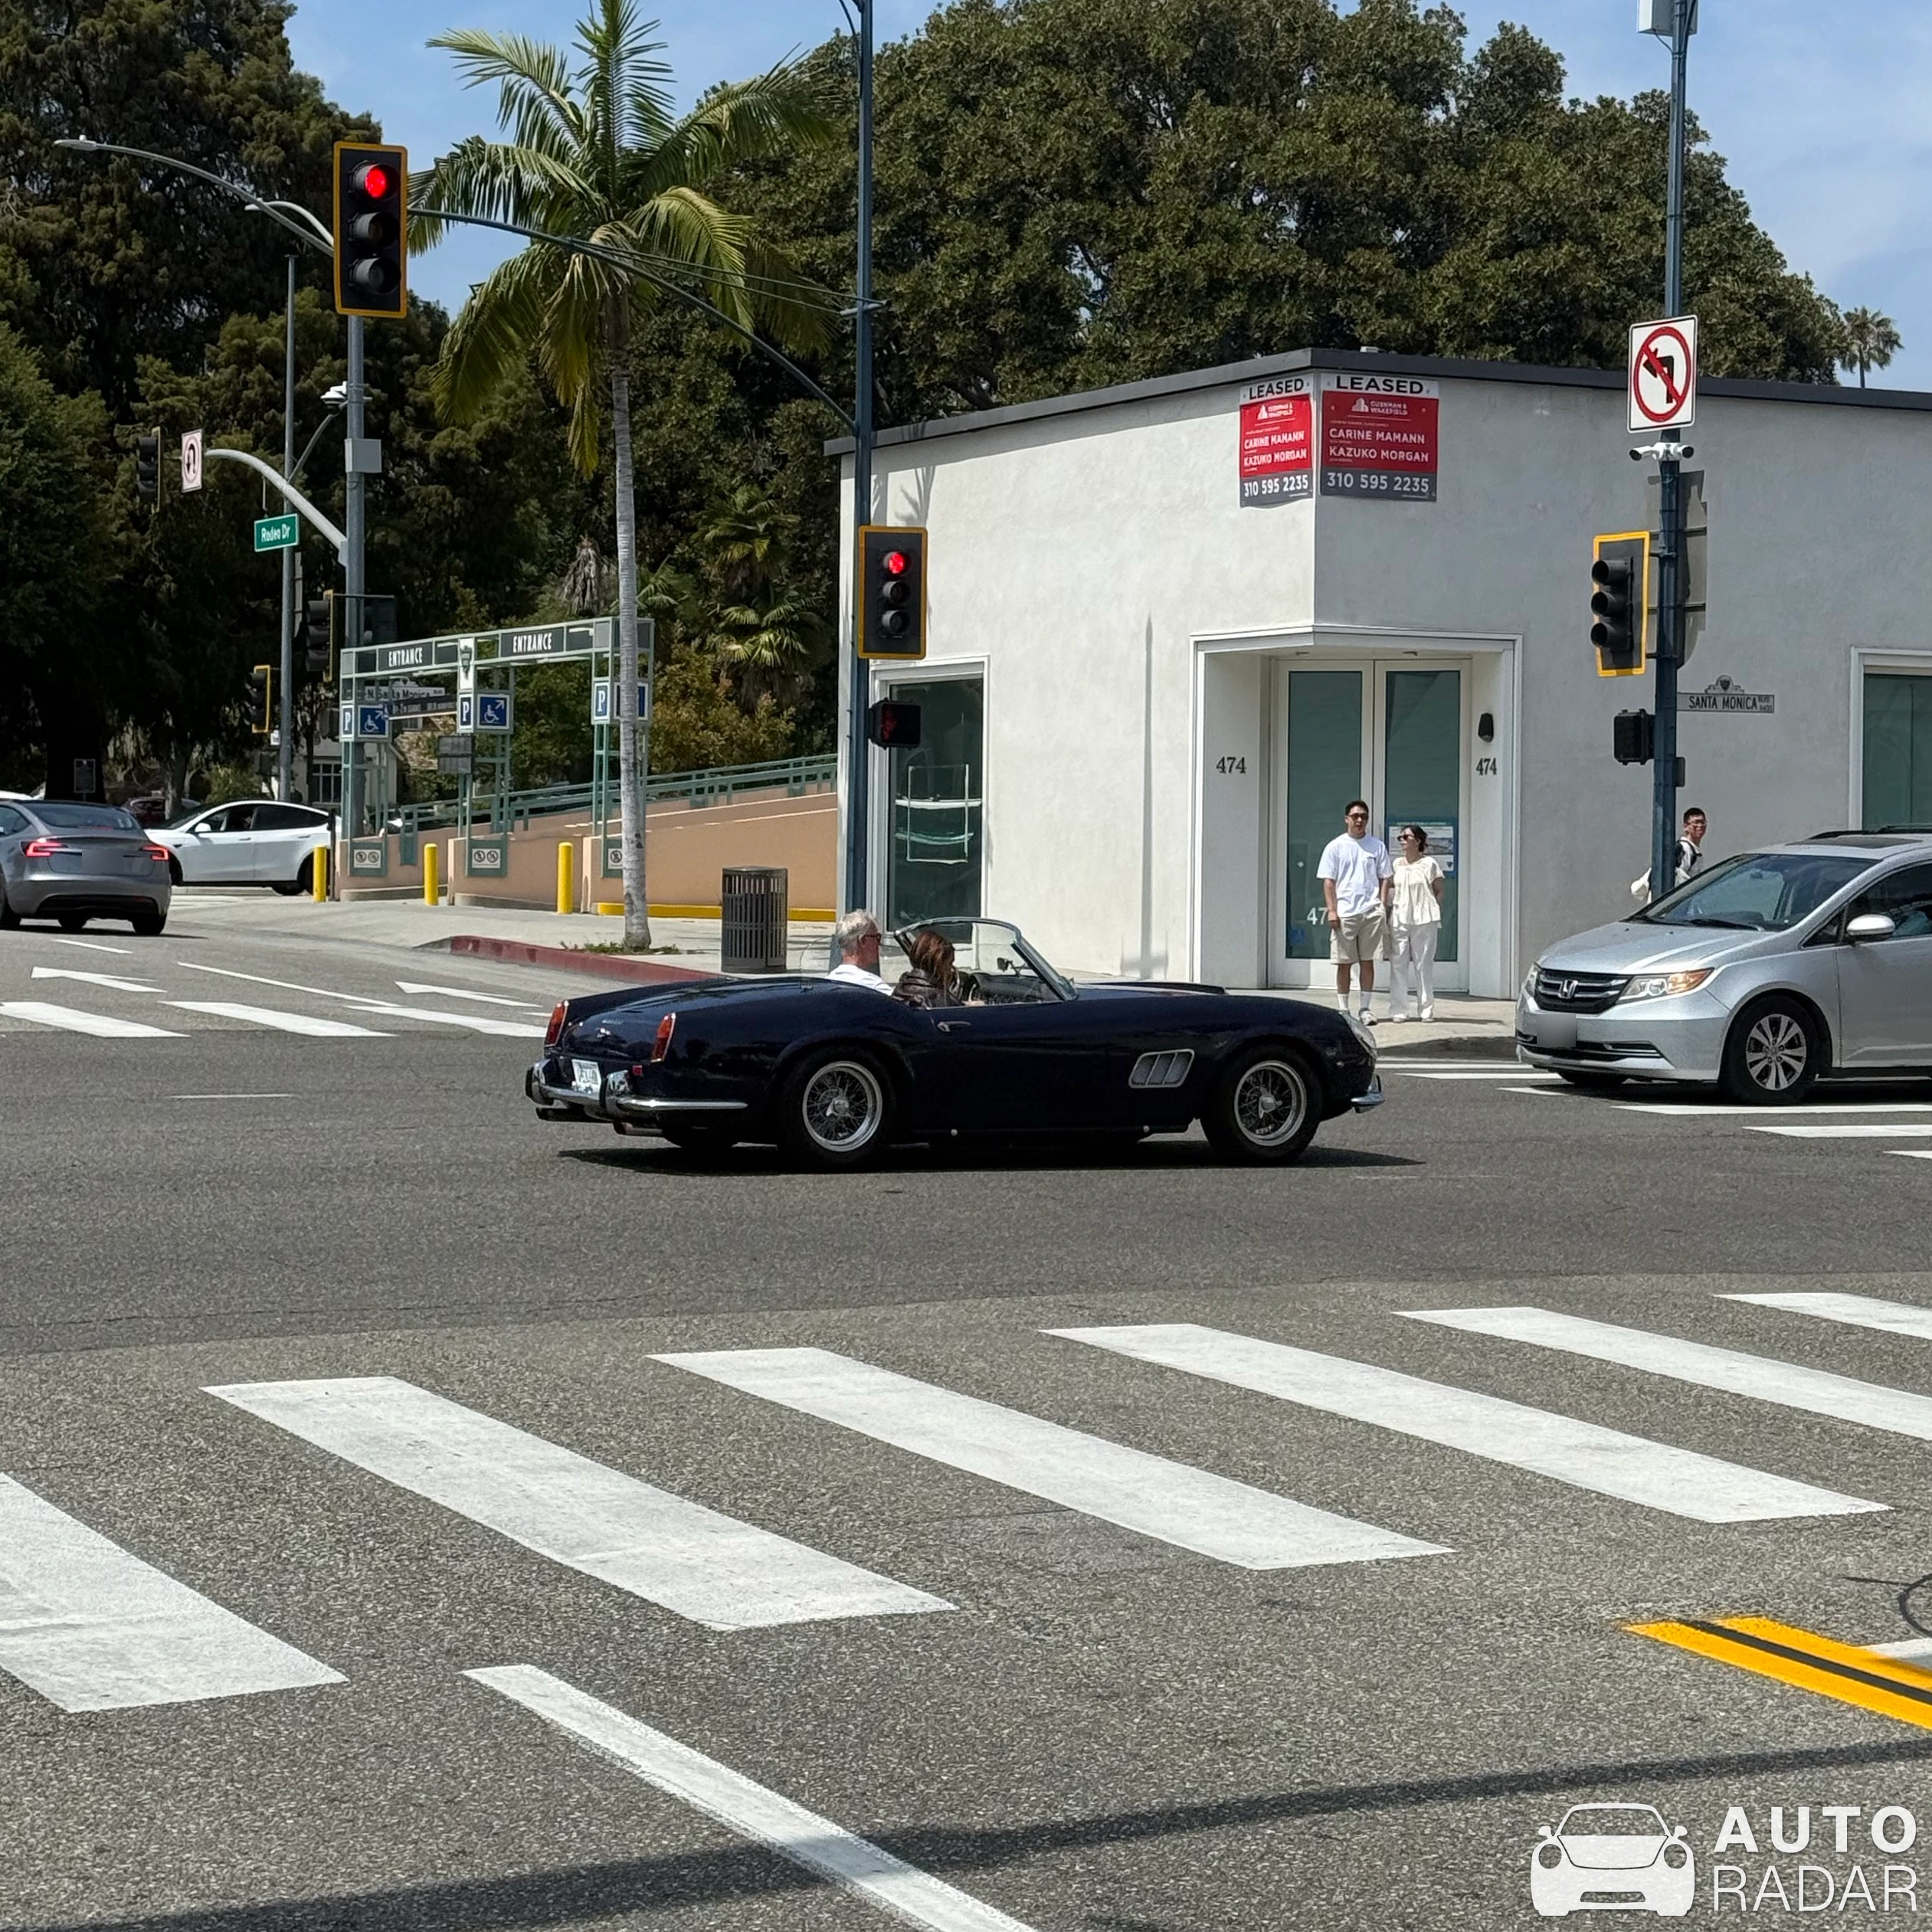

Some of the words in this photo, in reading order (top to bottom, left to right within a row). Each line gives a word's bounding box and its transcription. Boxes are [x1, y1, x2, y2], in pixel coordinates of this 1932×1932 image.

[1249, 378, 1304, 400] LEASED
[1336, 375, 1423, 395] LEASED
[1271, 431, 1305, 445] MAMANN
[1329, 428, 1373, 440] CARINE
[1376, 431, 1426, 444] MAMANN
[1244, 454, 1272, 467] KAZUKO
[1273, 448, 1307, 463] MORGAN
[1329, 446, 1377, 459] KAZUKO
[1380, 450, 1429, 463] MORGAN
[1244, 481, 1259, 497] 310
[1262, 478, 1280, 495] 595
[1283, 475, 1308, 492] 2235
[1327, 472, 1354, 488] 310
[1360, 474, 1388, 490] 595
[1393, 476, 1429, 493] 2235
[282, 523, 291, 539] Dr
[512, 633, 552, 653] ENTRANCE
[388, 647, 423, 667] ENTRANCE
[598, 690, 606, 712] P
[1688, 696, 1718, 709] SANTA
[1722, 696, 1757, 711] MONICA
[462, 701, 470, 722] P
[345, 712, 351, 731] P
[1216, 756, 1247, 774] 474
[1475, 758, 1497, 775] 474
